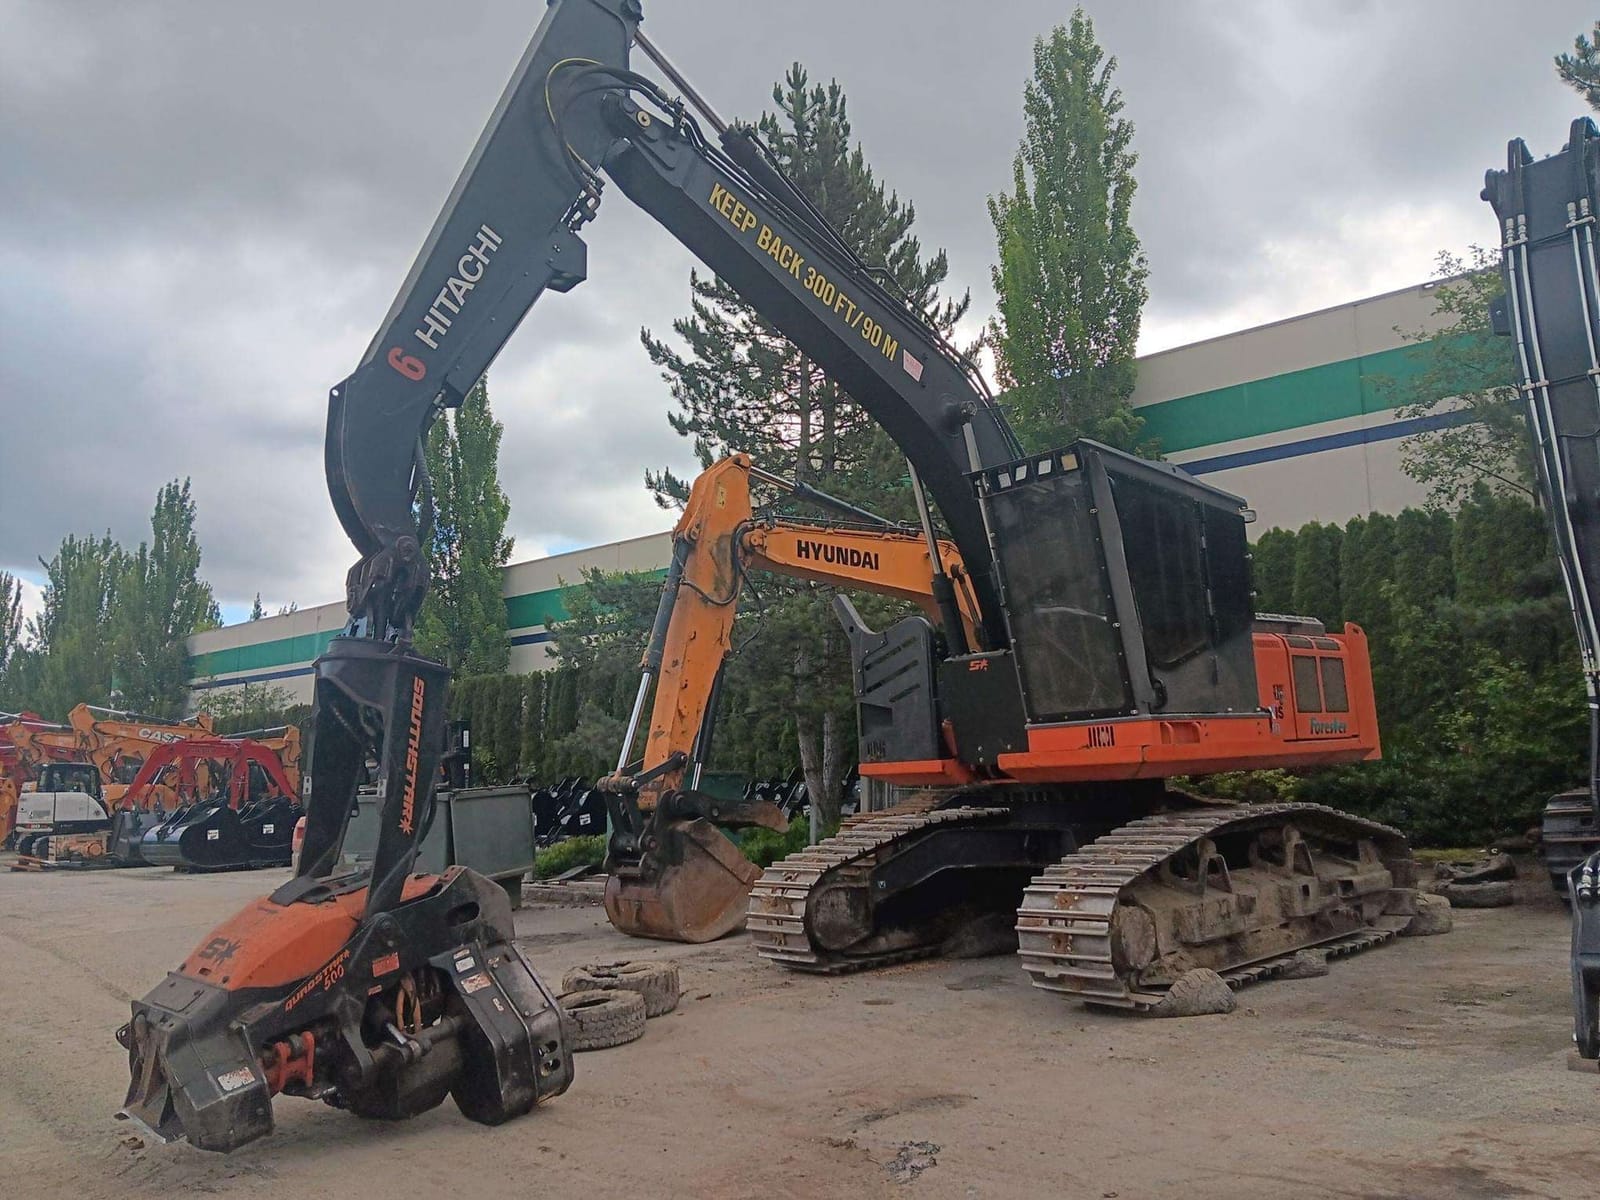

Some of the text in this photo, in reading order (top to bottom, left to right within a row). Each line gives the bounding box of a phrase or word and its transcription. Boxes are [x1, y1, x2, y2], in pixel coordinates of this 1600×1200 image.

[708, 182, 757, 232] KEEP
[757, 224, 805, 279] BACK
[414, 224, 503, 350] HITACHI
[387, 346, 427, 381] 6
[797, 540, 879, 570] HYUNDAI
[1310, 718, 1347, 735] Forester
[402, 675, 425, 822] SOUTHSTAR
[324, 964, 344, 991] 500
